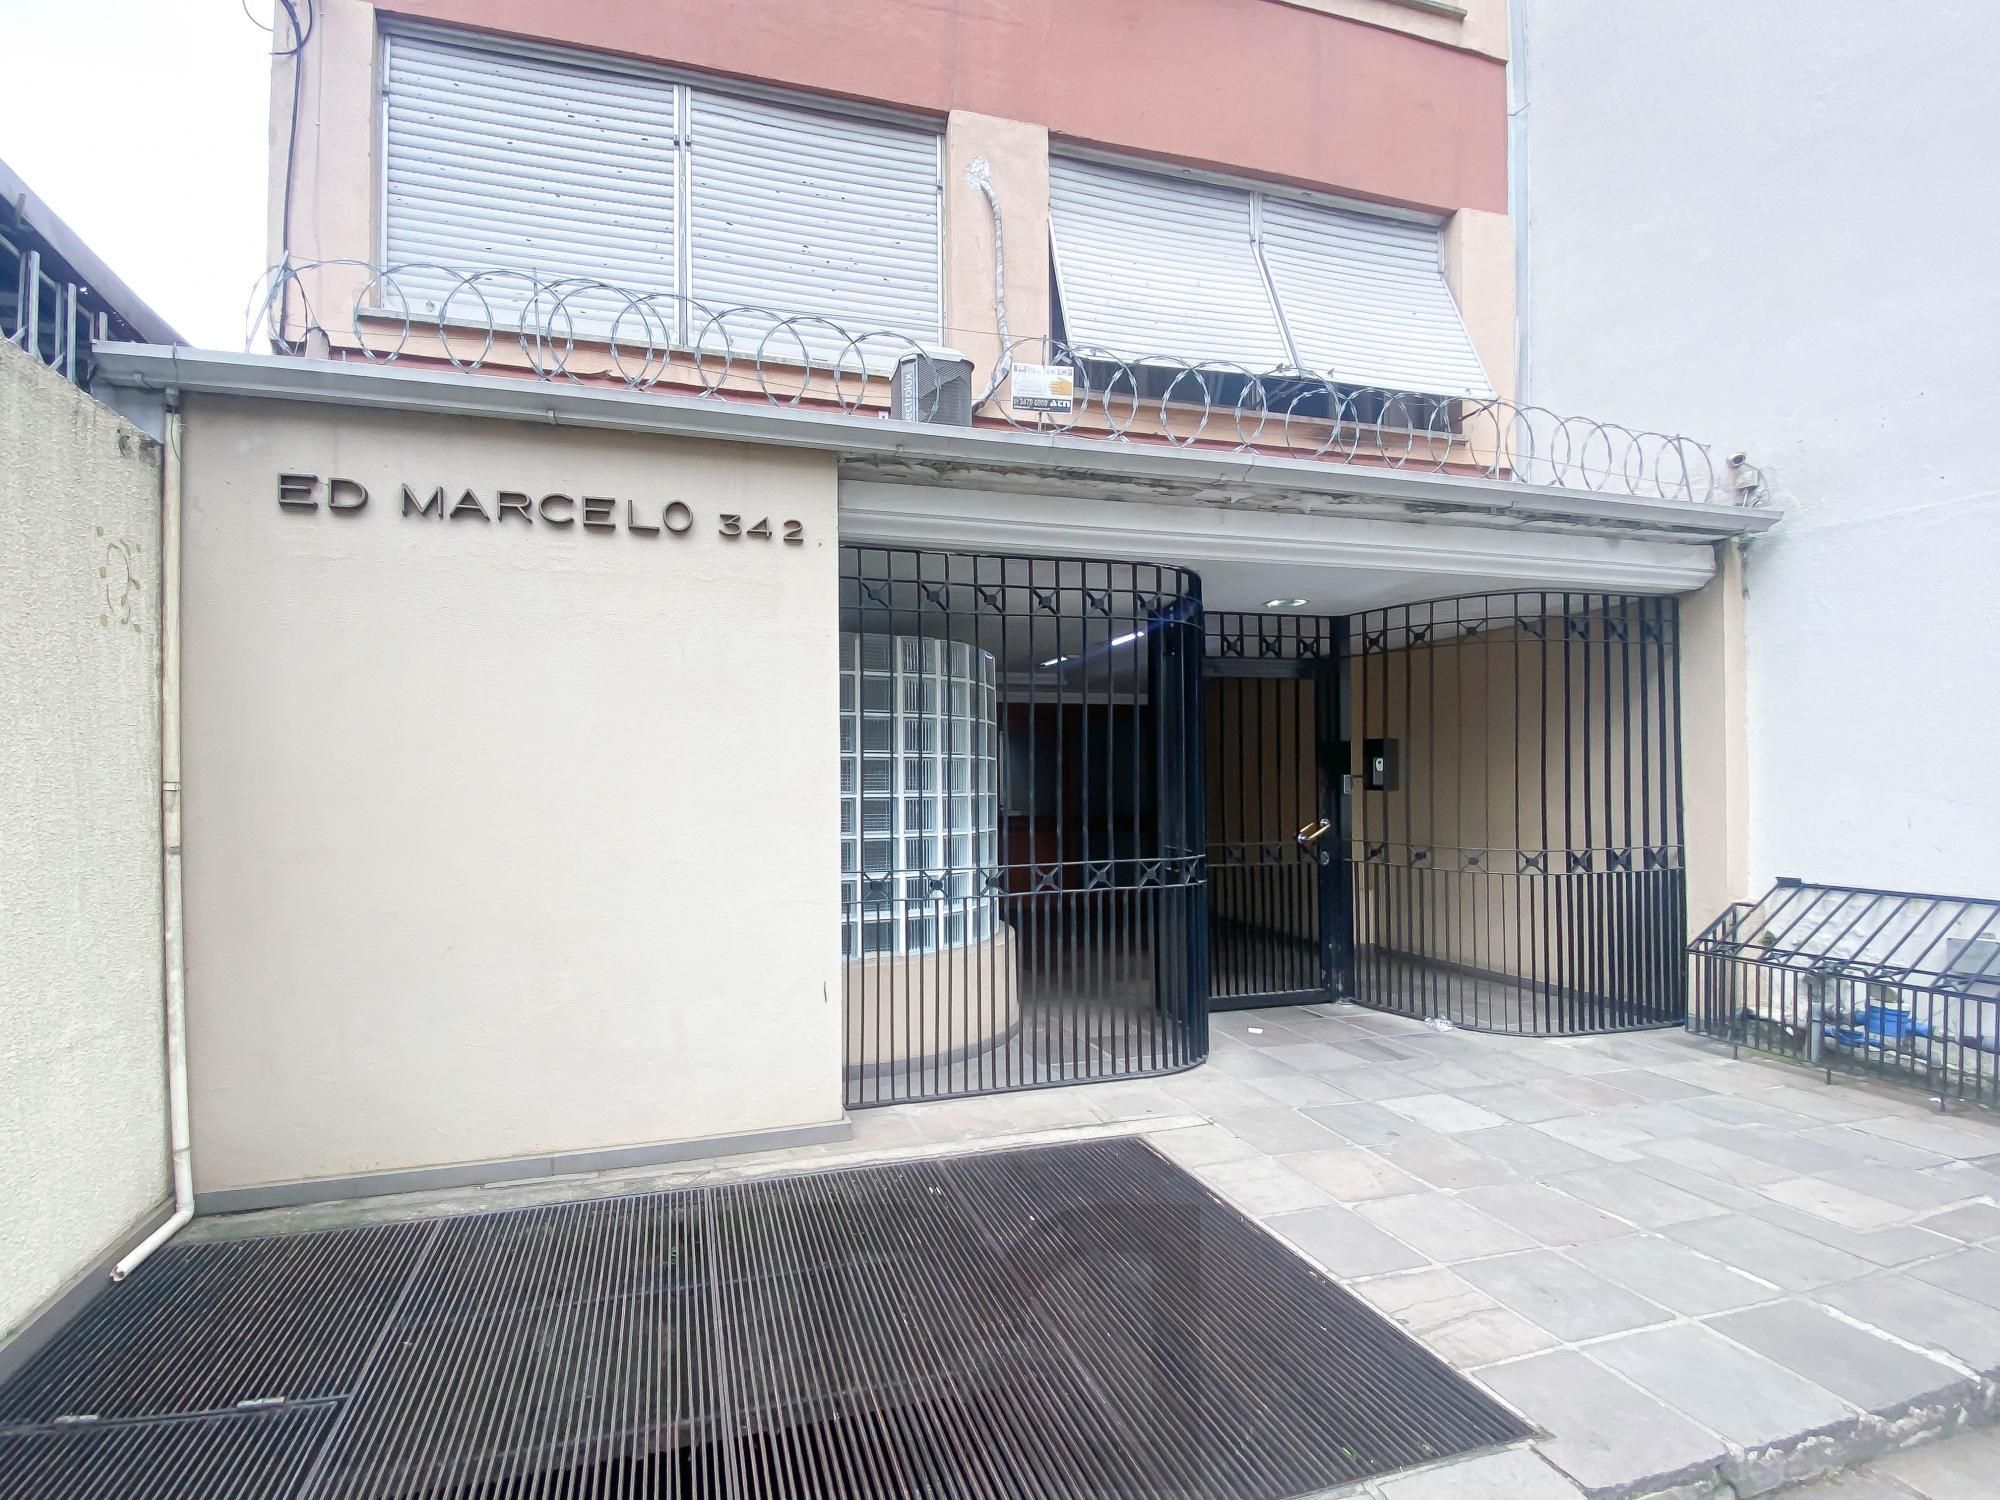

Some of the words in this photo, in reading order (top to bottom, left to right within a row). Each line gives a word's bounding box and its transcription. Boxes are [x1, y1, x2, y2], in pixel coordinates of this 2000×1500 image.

[903, 372, 913, 423] lectrolux
[277, 472, 370, 514] ED
[400, 483, 695, 536] MARCELO
[718, 513, 804, 545] 342
